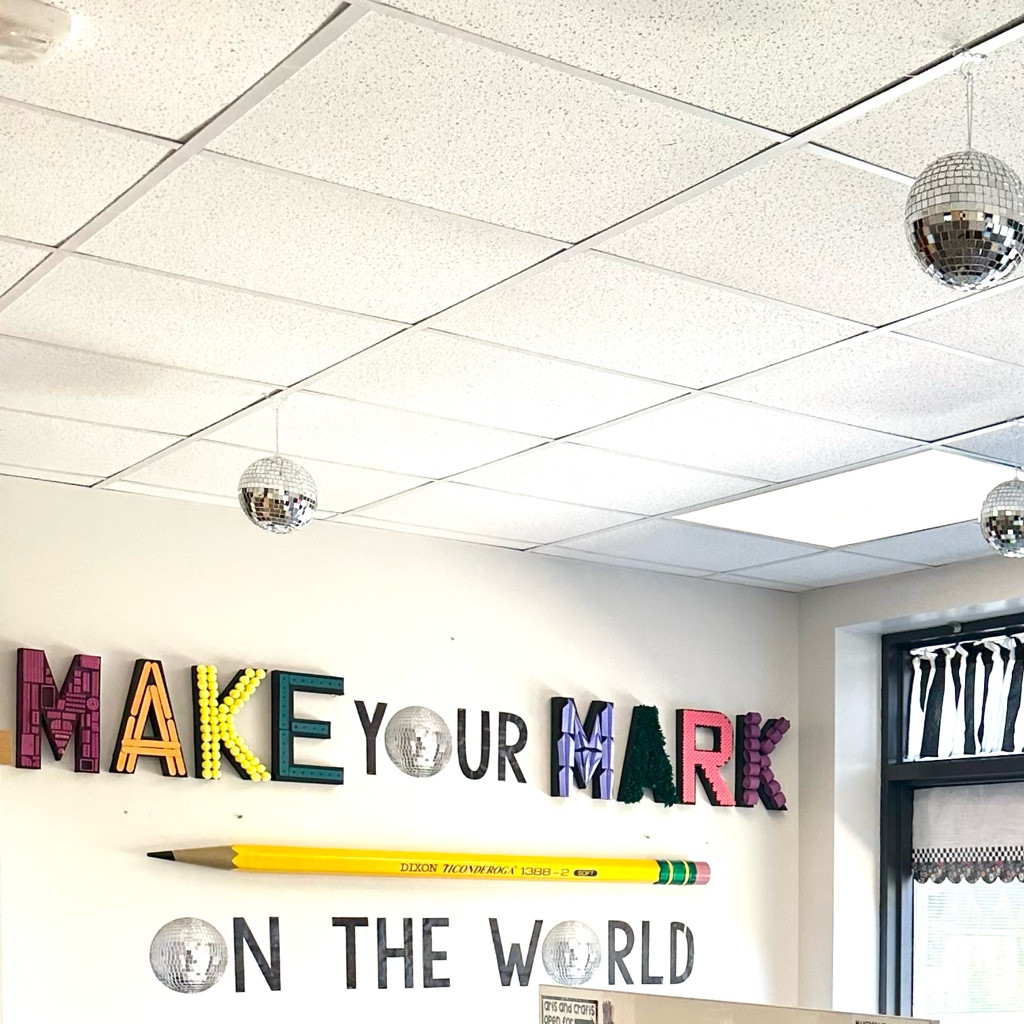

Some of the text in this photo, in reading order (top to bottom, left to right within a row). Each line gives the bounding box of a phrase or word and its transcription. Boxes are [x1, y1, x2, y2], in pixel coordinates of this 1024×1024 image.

[15, 647, 788, 811] MAKE YOUR MARK
[400, 862, 438, 873] DIXON
[442, 864, 515, 875] TICONDEROGA
[149, 916, 695, 993] ON THE WORLD
[544, 1001, 595, 1016] arts and crafts
